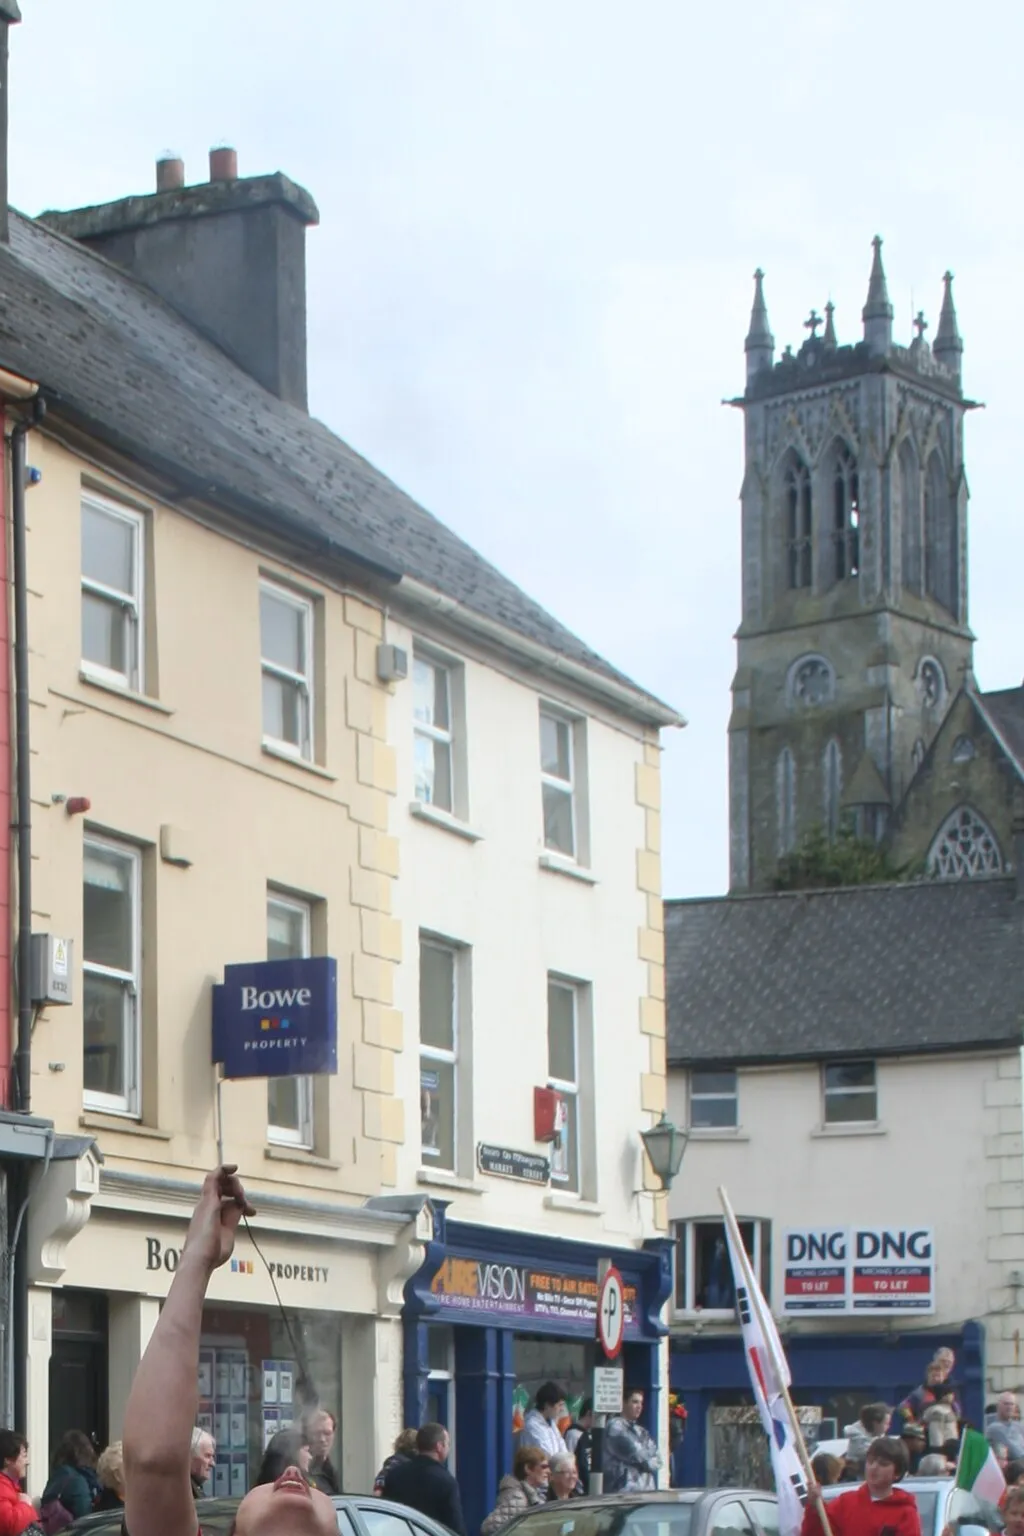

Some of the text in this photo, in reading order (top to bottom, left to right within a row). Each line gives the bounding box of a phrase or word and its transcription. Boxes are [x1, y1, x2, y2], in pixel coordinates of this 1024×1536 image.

[240, 985, 312, 1011] Bowe
[243, 1037, 308, 1051] PROPERTY
[787, 1231, 846, 1261] DNG
[856, 1231, 932, 1260] DNG
[146, 1236, 329, 1283] Bo PROPERTY
[801, 1281, 829, 1292] TO LET
[873, 1280, 909, 1290] TO LET
